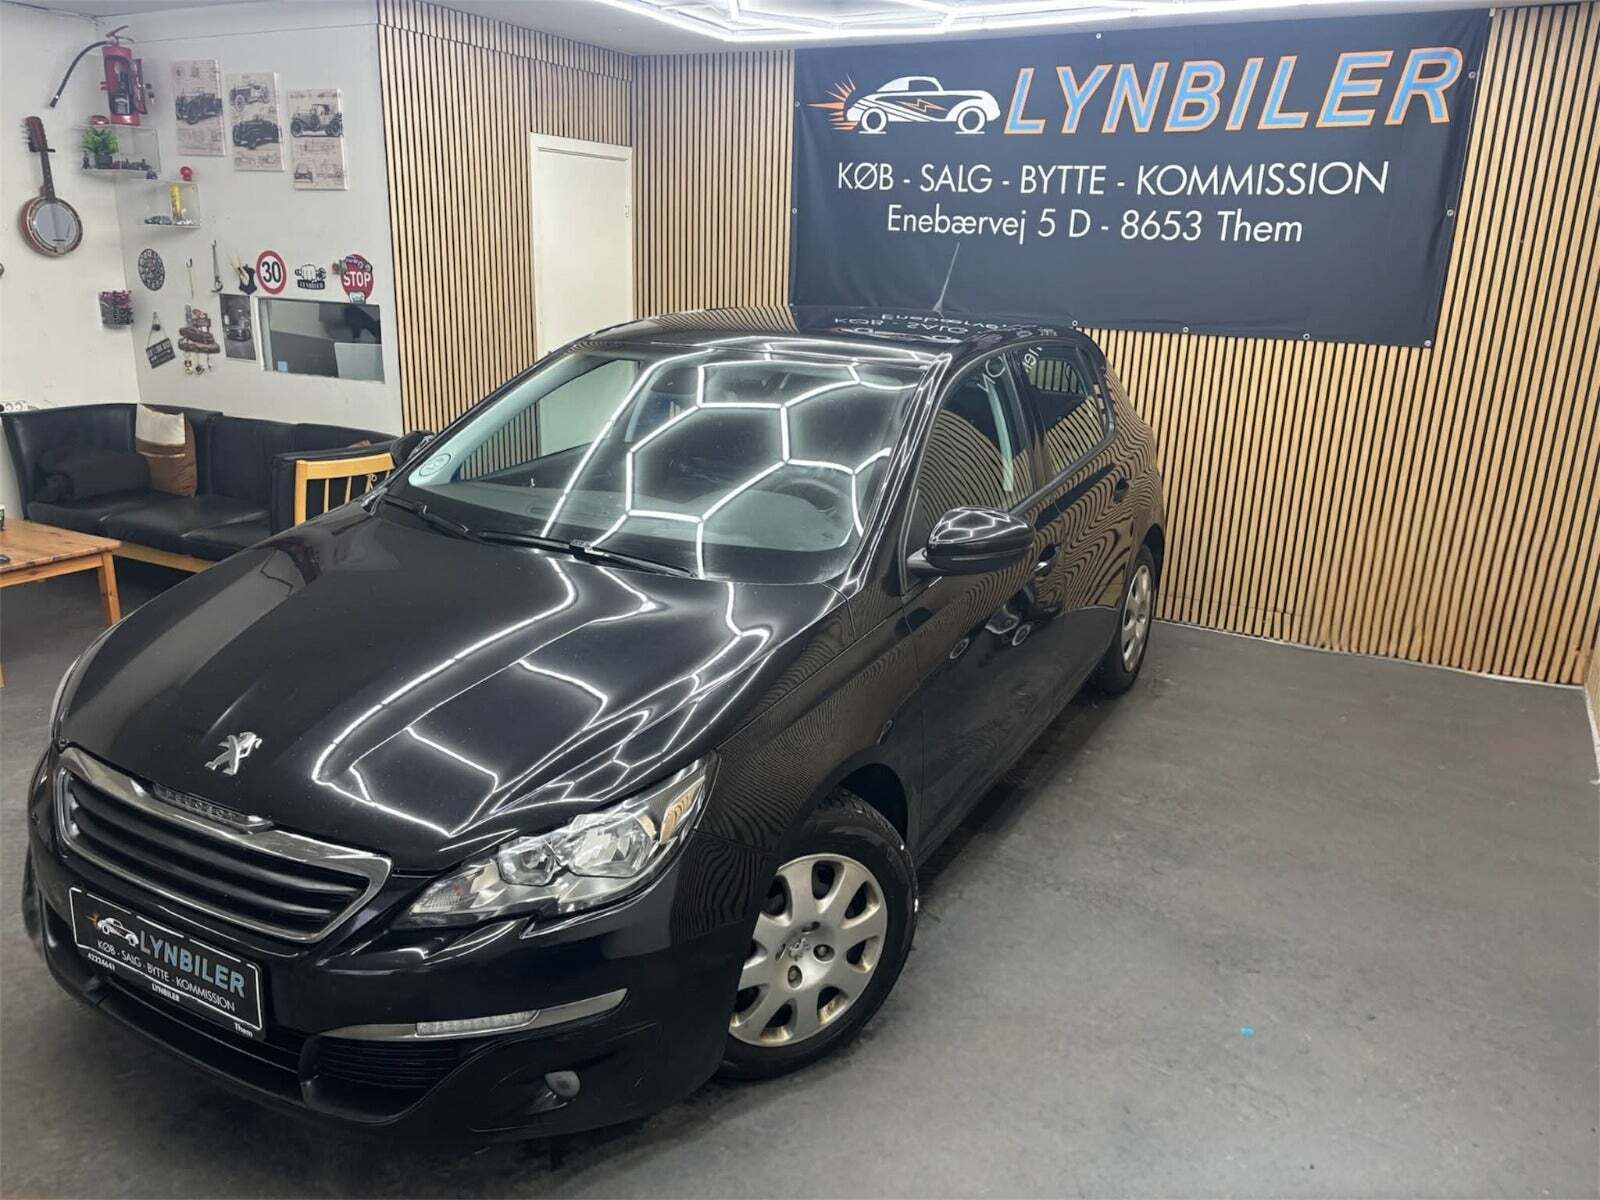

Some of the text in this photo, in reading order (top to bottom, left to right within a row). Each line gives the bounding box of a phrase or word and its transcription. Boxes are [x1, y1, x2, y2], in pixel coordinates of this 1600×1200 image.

[1004, 46, 1464, 134] LYNBILER
[838, 162, 894, 190] KØB
[920, 163, 992, 193] SALG
[1020, 165, 1106, 195] BYTTE
[1136, 161, 1389, 196] KOMMISSION
[887, 203, 1027, 245] Enebærvej
[1038, 208, 1056, 237] 5
[1069, 209, 1091, 238] D
[1120, 209, 1202, 241] 8653
[1217, 208, 1303, 242] Them
[262, 261, 281, 283] 30
[343, 271, 371, 287] STOP
[121, 950, 142, 968] SALG
[147, 962, 170, 983] BYTTE
[175, 976, 236, 1012] KOMMISSION
[140, 930, 245, 999] LYNBILER
